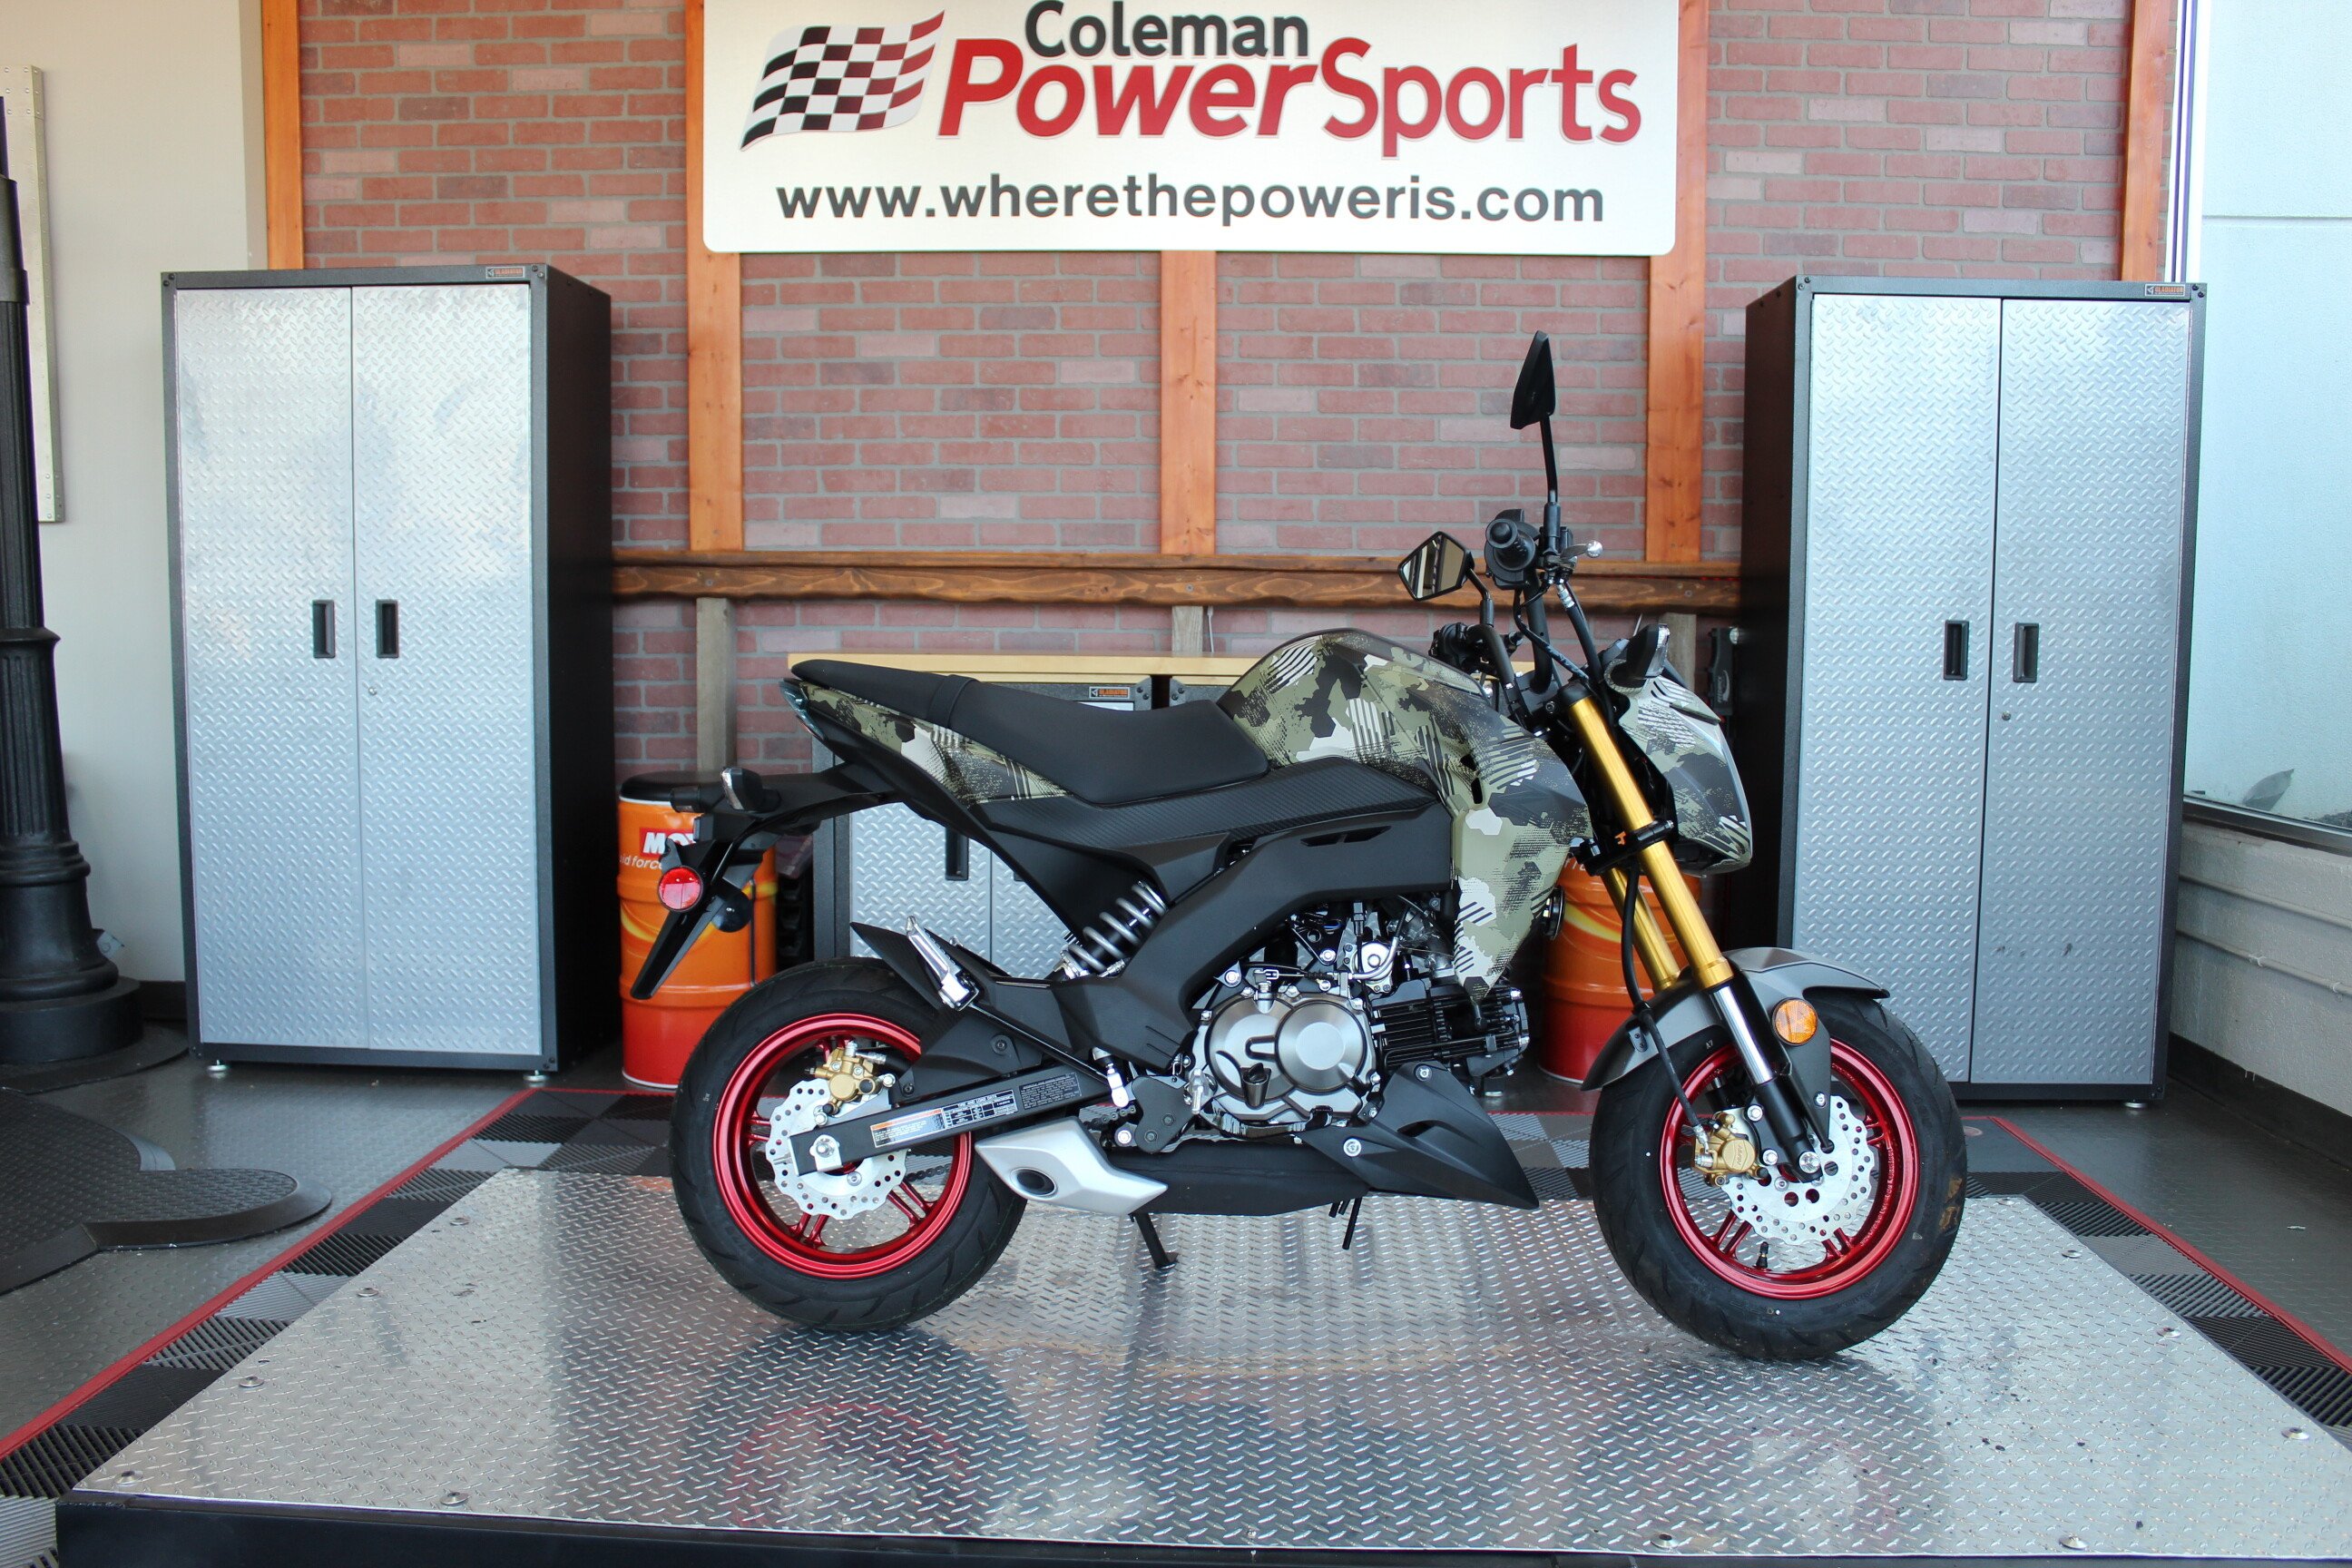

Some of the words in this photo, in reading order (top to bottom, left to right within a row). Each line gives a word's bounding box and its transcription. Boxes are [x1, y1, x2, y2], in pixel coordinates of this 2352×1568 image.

[1025, 0, 1308, 57] Coleman
[938, 36, 1642, 158] PowerSports
[777, 172, 1603, 227] www.wherethepoweris.com
